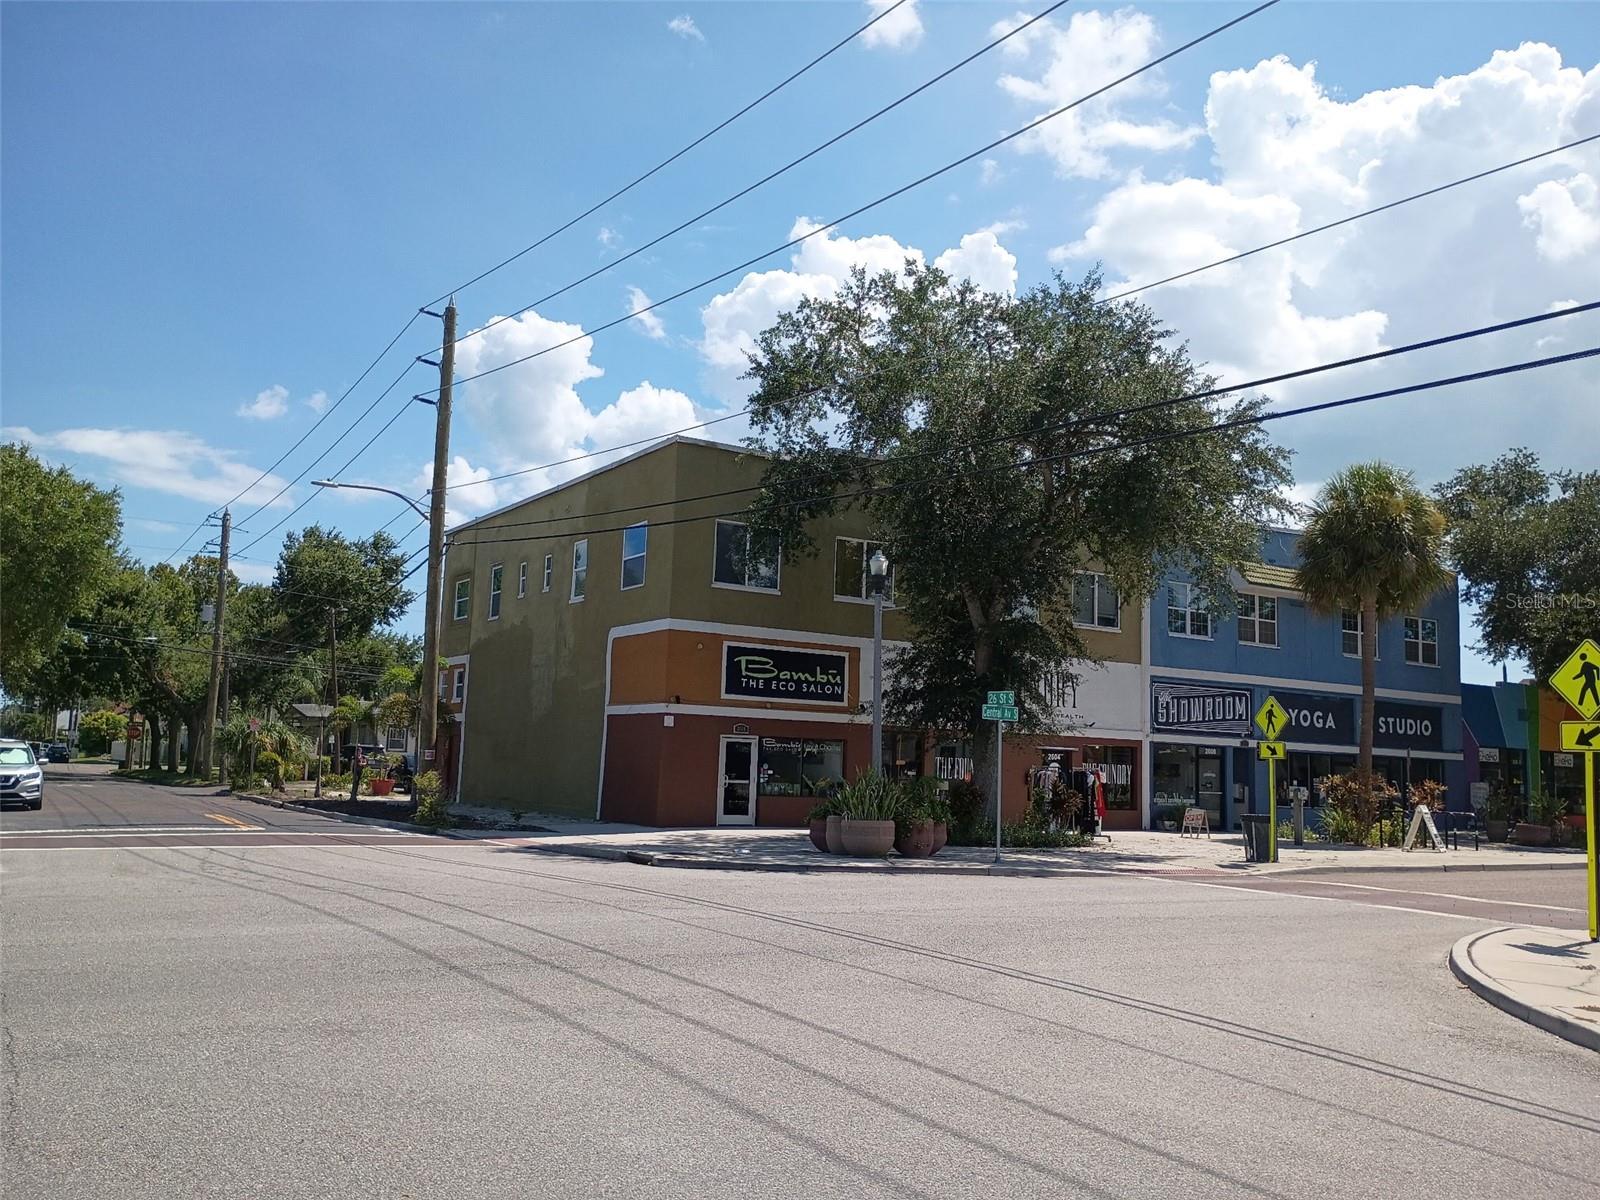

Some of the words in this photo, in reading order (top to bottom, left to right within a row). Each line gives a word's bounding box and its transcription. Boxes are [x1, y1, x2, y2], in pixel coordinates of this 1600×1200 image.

[741, 678, 764, 689] THE
[771, 680, 796, 691] ECO
[802, 683, 842, 695] SALON
[988, 693, 998, 704] 26
[999, 693, 1007, 704] St
[1008, 693, 1013, 704] S
[983, 706, 1002, 718] Central
[1158, 696, 1246, 723] SHOWROOM
[1288, 708, 1336, 729] YOGA
[1378, 716, 1432, 736] STUDIO
[935, 757, 953, 780] THE
